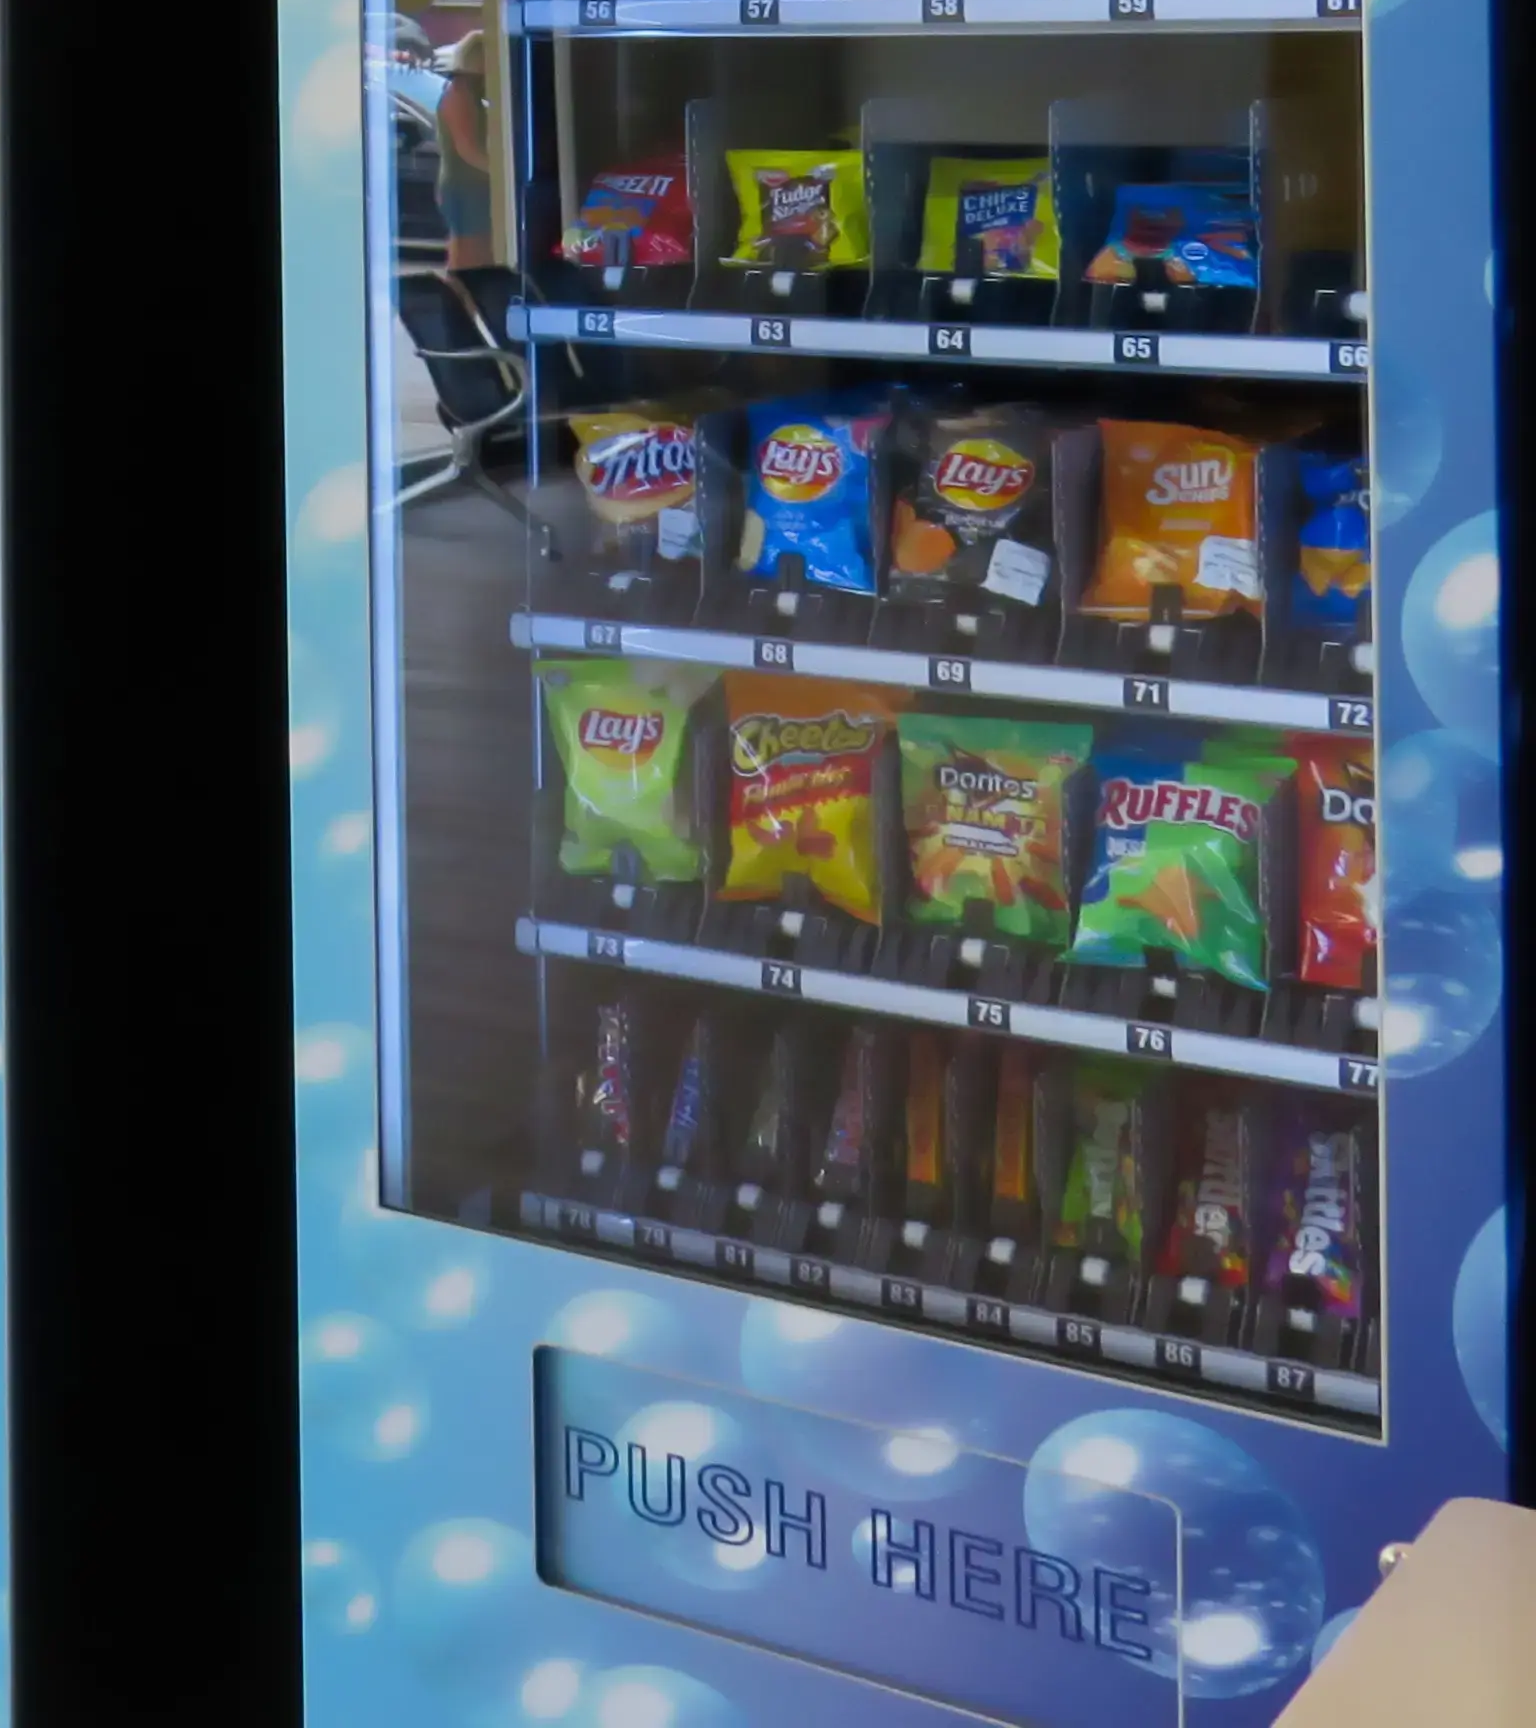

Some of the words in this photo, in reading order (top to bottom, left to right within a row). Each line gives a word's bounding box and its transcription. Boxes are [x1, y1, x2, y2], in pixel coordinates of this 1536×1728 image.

[584, 0, 611, 20] 56
[771, 184, 823, 207] Fudge
[963, 189, 1029, 212] CHIPS
[964, 202, 1029, 225] DELUXE
[584, 313, 609, 333] 62
[757, 321, 785, 341] 63
[936, 329, 964, 350] 64
[1121, 337, 1151, 358] 65
[1337, 345, 1369, 367] 66
[762, 440, 841, 484] Lay's
[940, 454, 1027, 495] Lay's
[1146, 458, 1234, 505] Sun
[590, 627, 616, 646] 67
[761, 641, 787, 664] 68
[936, 660, 965, 683] 69
[1133, 682, 1160, 704] 71
[1337, 702, 1370, 727] 72
[584, 712, 660, 753] Lay's
[939, 766, 1037, 800] Doritos
[1099, 779, 1261, 843] RUFFLES
[593, 935, 619, 954] 73
[768, 968, 795, 989] 74
[975, 1001, 1003, 1026] 75
[1135, 1027, 1165, 1051] 76
[1348, 1061, 1378, 1087] 77
[724, 1245, 747, 1266] 81
[797, 1262, 824, 1284] 82
[889, 1282, 917, 1306] 83
[975, 1303, 1003, 1326] 84
[1065, 1323, 1093, 1346] 85
[1164, 1341, 1193, 1367] 86
[1277, 1367, 1306, 1391] 87
[565, 1424, 827, 1570] PUSH
[871, 1508, 1154, 1662] HERE
